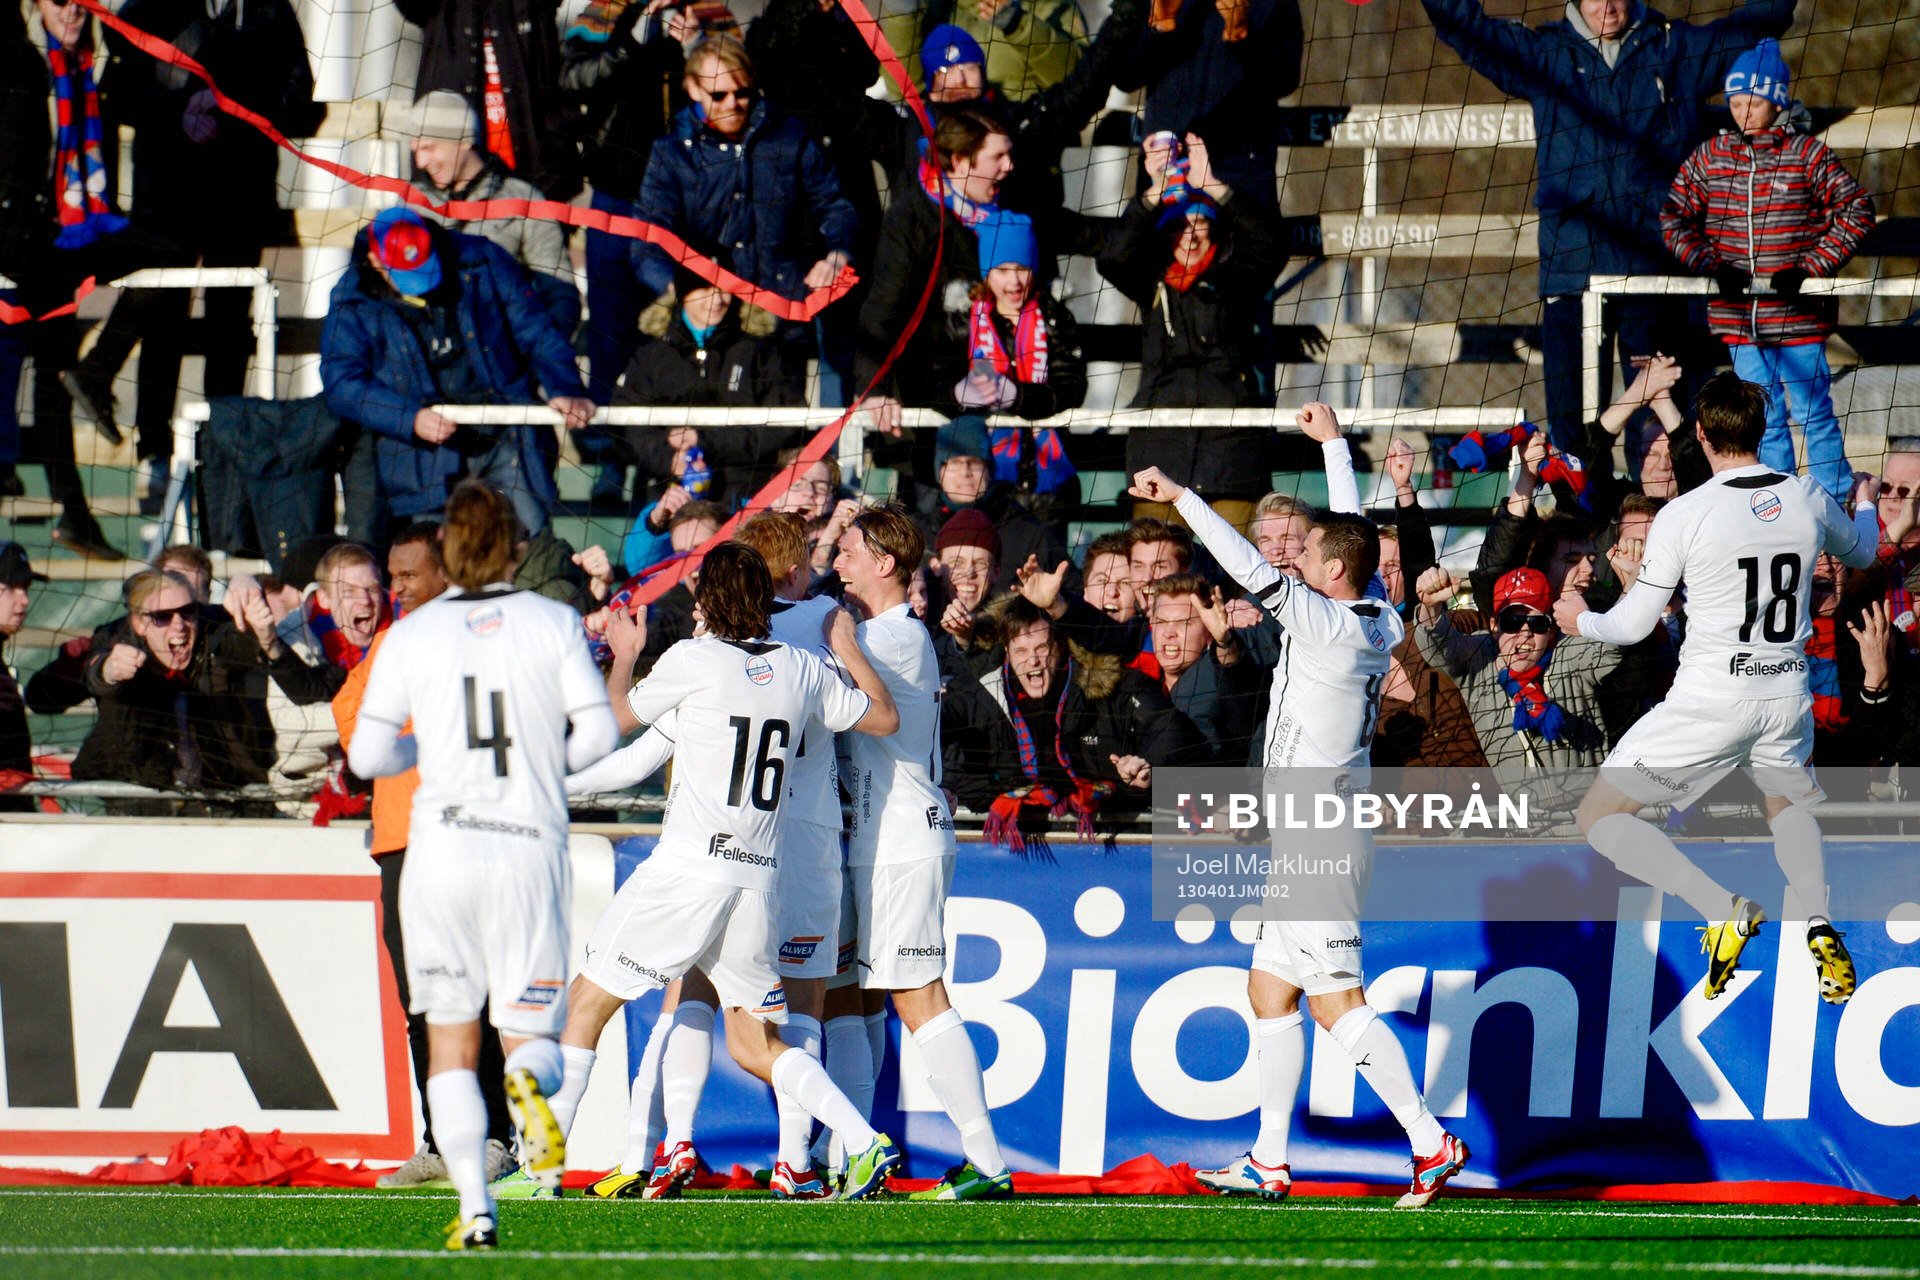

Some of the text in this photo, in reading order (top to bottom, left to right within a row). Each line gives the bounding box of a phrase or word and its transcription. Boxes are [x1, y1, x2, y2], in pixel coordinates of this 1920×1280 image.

[1738, 552, 1802, 643] 18
[1736, 659, 1805, 677] Fellessons
[464, 676, 512, 777] 4
[727, 715, 790, 812] 16
[713, 841, 778, 869] Fellessons
[781, 944, 814, 955] ALWEX
